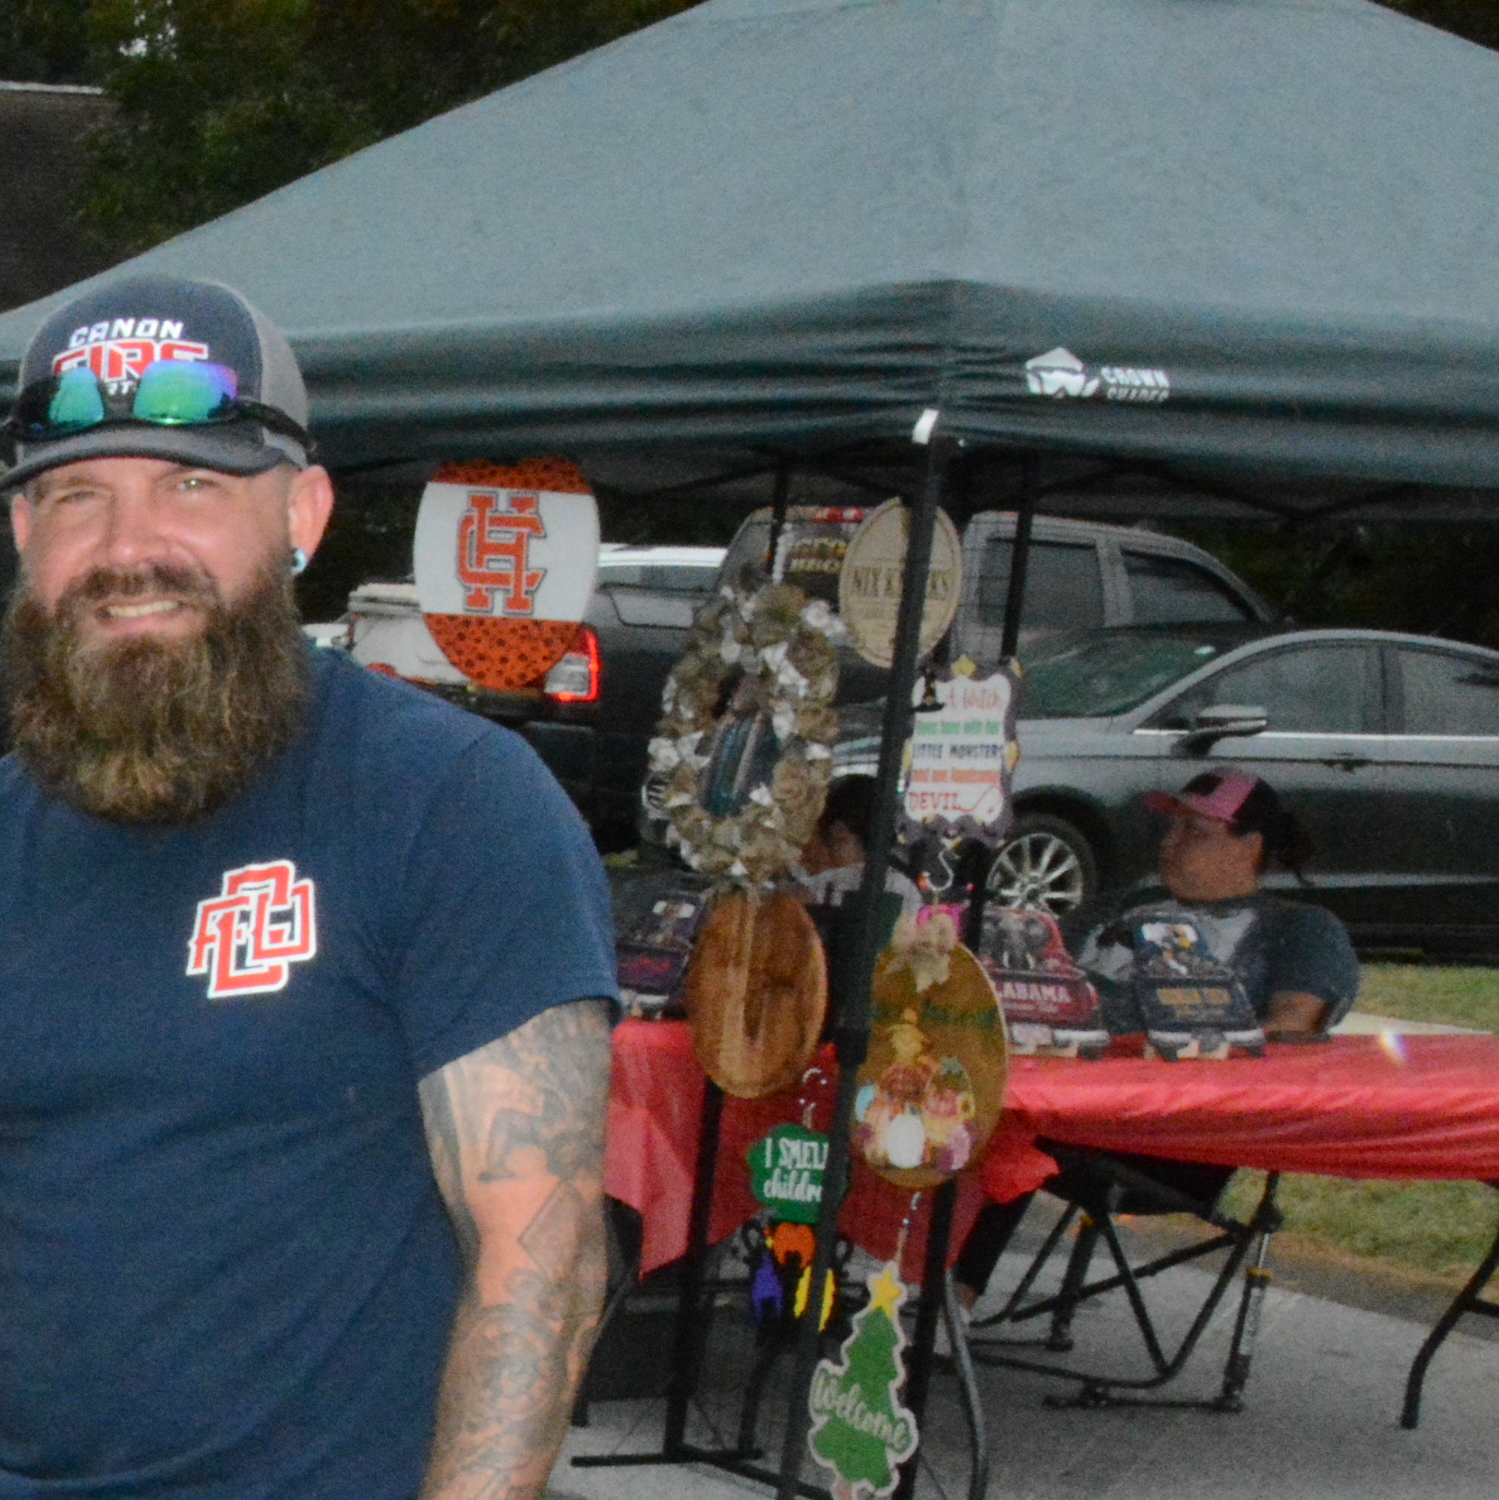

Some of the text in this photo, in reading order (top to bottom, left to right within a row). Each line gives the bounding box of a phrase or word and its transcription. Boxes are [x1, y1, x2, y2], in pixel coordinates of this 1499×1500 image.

[69, 318, 184, 349] CANON
[909, 792, 959, 812] DEVIL
[996, 982, 1072, 1003] LABAMA
[765, 1137, 773, 1169] I
[764, 1167, 823, 1202] childr
[814, 1369, 907, 1449] Welcome
